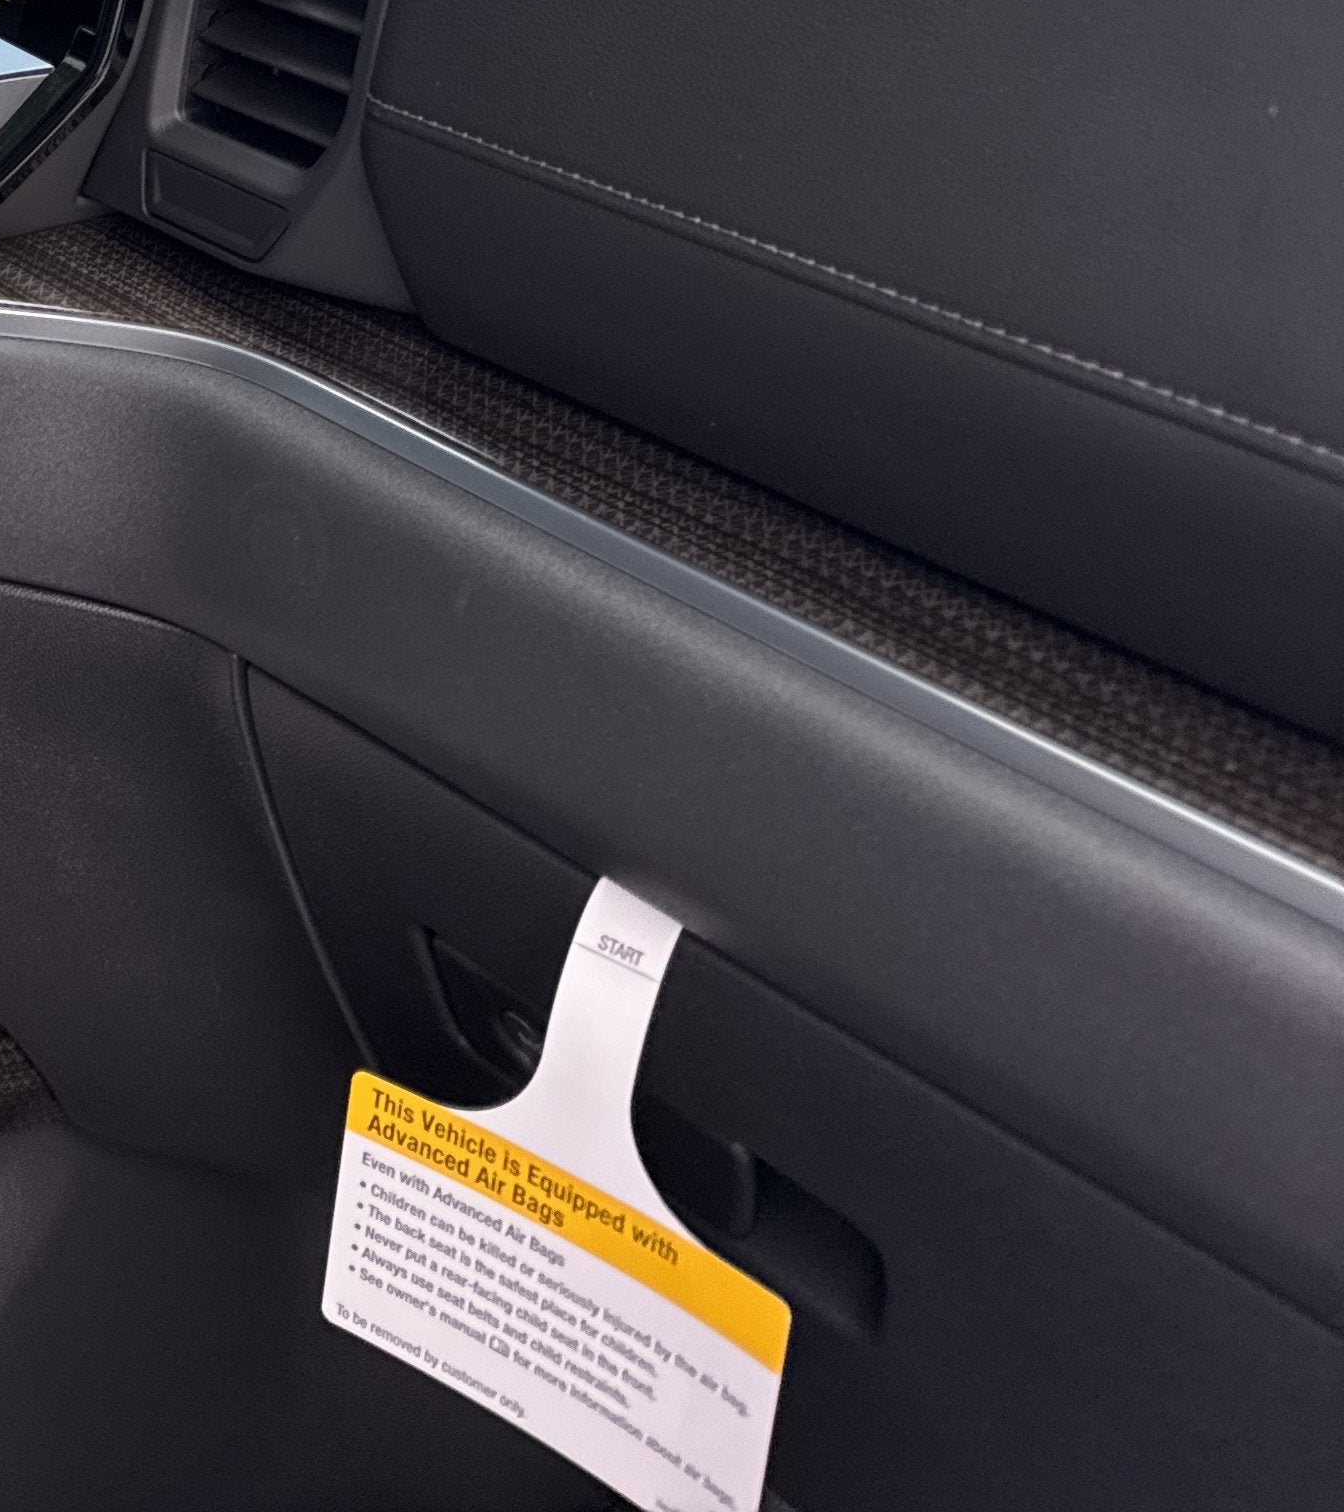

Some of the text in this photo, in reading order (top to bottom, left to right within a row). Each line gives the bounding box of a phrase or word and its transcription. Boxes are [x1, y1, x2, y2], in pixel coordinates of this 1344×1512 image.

[597, 934, 645, 967] START
[361, 1151, 566, 1267] Even with Advanced Air Bags
[367, 1114, 565, 1228] Advanced Air Bags
[372, 1088, 680, 1266] This Vehicle is Equipped with
[361, 1247, 408, 1279] Always
[411, 1273, 434, 1293] use
[437, 1287, 465, 1310] seat
[468, 1301, 500, 1329] belts
[502, 1323, 528, 1345] and
[530, 1339, 562, 1365] child
[365, 1225, 403, 1253] Never
[405, 1247, 427, 1267] put
[429, 1260, 438, 1273] a
[441, 1266, 514, 1316] rear-facing
[515, 1307, 548, 1333] child
[550, 1328, 579, 1352] seat
[581, 1343, 595, 1362] in
[597, 1353, 619, 1377] the
[368, 1203, 392, 1226] The
[394, 1217, 426, 1243] back
[428, 1236, 457, 1260] seat
[460, 1250, 471, 1267] is
[475, 1258, 495, 1280] the
[498, 1274, 539, 1304] safest
[540, 1298, 577, 1327] place
[580, 1318, 599, 1340] for
[370, 1183, 427, 1221] Children
[430, 1215, 455, 1235] can
[458, 1226, 475, 1246] be
[479, 1237, 517, 1268] killed
[519, 1263, 535, 1278] or
[538, 1273, 601, 1318] seriously
[603, 1308, 651, 1348] injured
[654, 1340, 672, 1362] by
[674, 1353, 697, 1378] the
[700, 1373, 719, 1392] air
[336, 1302, 350, 1320] To
[352, 1310, 368, 1329] be
[370, 1322, 422, 1358] removed
[423, 1349, 439, 1369] by
[441, 1361, 498, 1399] customer
[359, 1267, 383, 1289] See
[386, 1283, 437, 1317] owner's
[439, 1311, 487, 1345] manual
[513, 1350, 531, 1369] for
[534, 1364, 567, 1392] more
[569, 1383, 644, 1441] information
[644, 1436, 682, 1469] about
[683, 1462, 701, 1482] air
